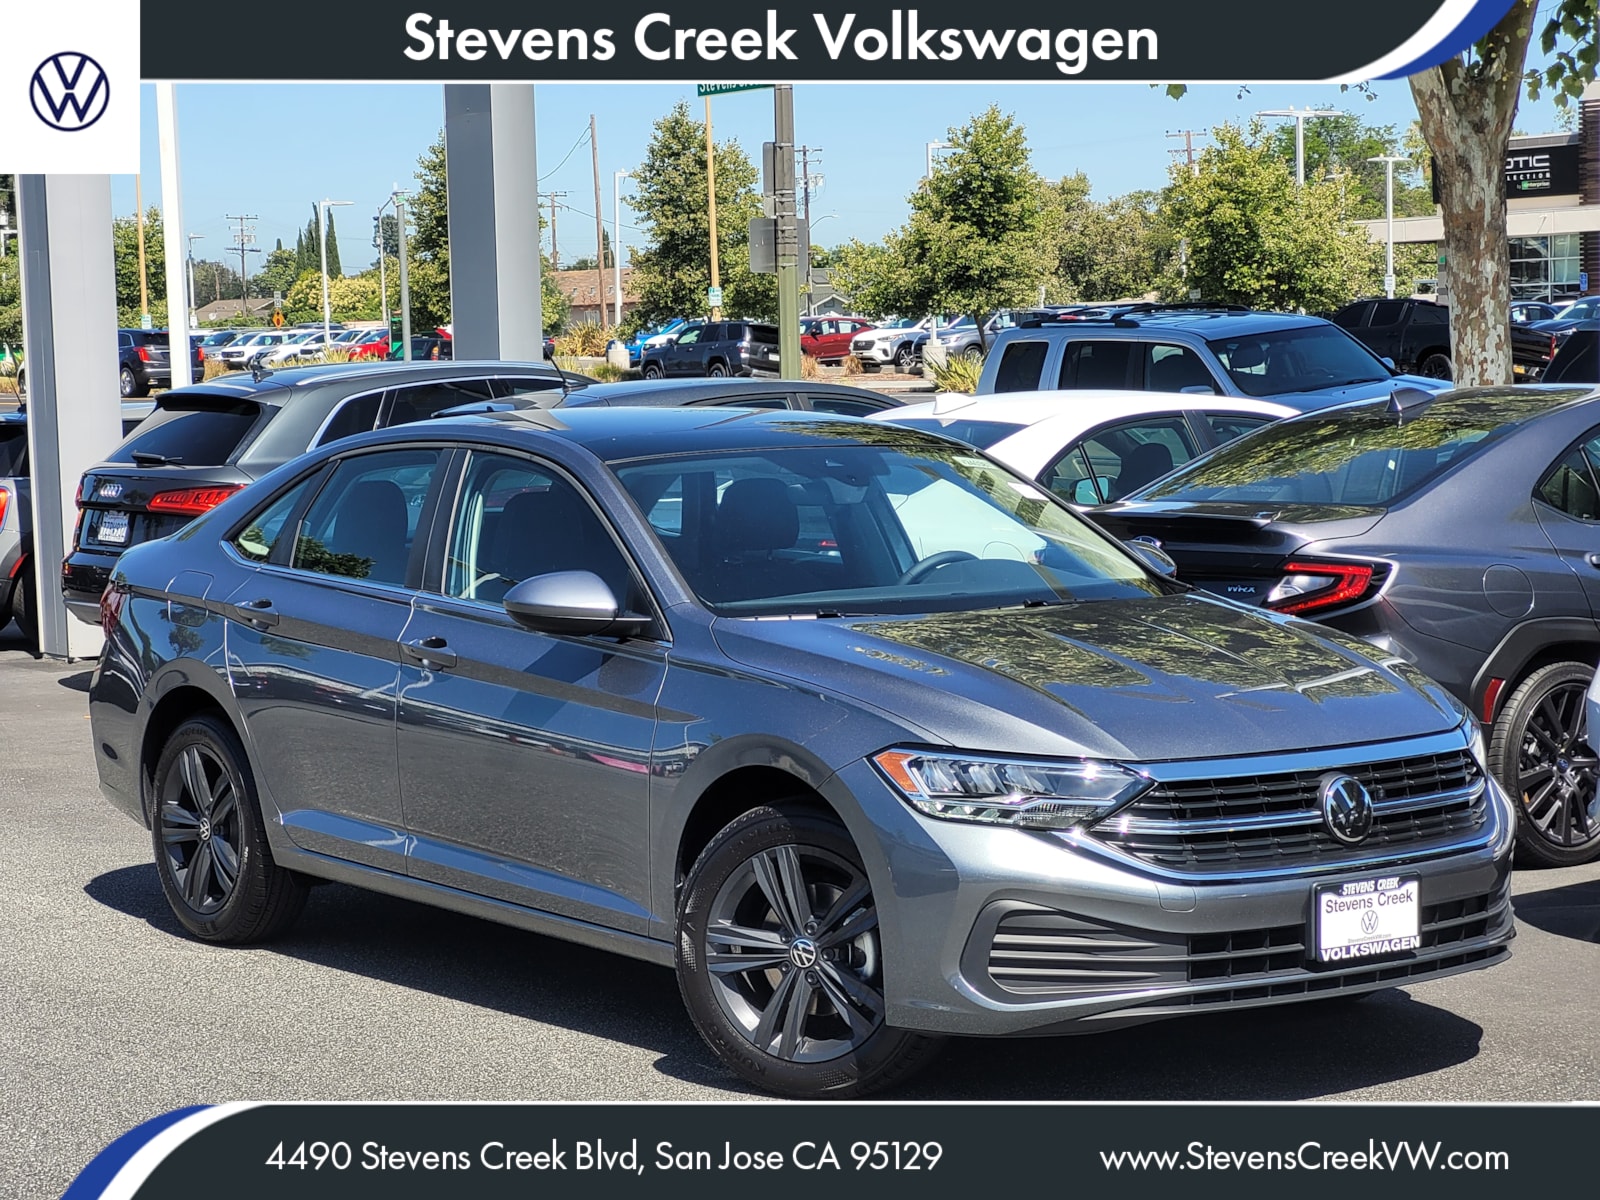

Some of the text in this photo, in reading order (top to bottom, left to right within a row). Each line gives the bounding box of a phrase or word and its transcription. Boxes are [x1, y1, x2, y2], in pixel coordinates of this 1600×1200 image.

[1343, 877, 1400, 895] STEVENS CREEK
[1325, 889, 1413, 913] Stevens Creek
[1320, 935, 1420, 961] VOLKSWAGEN
